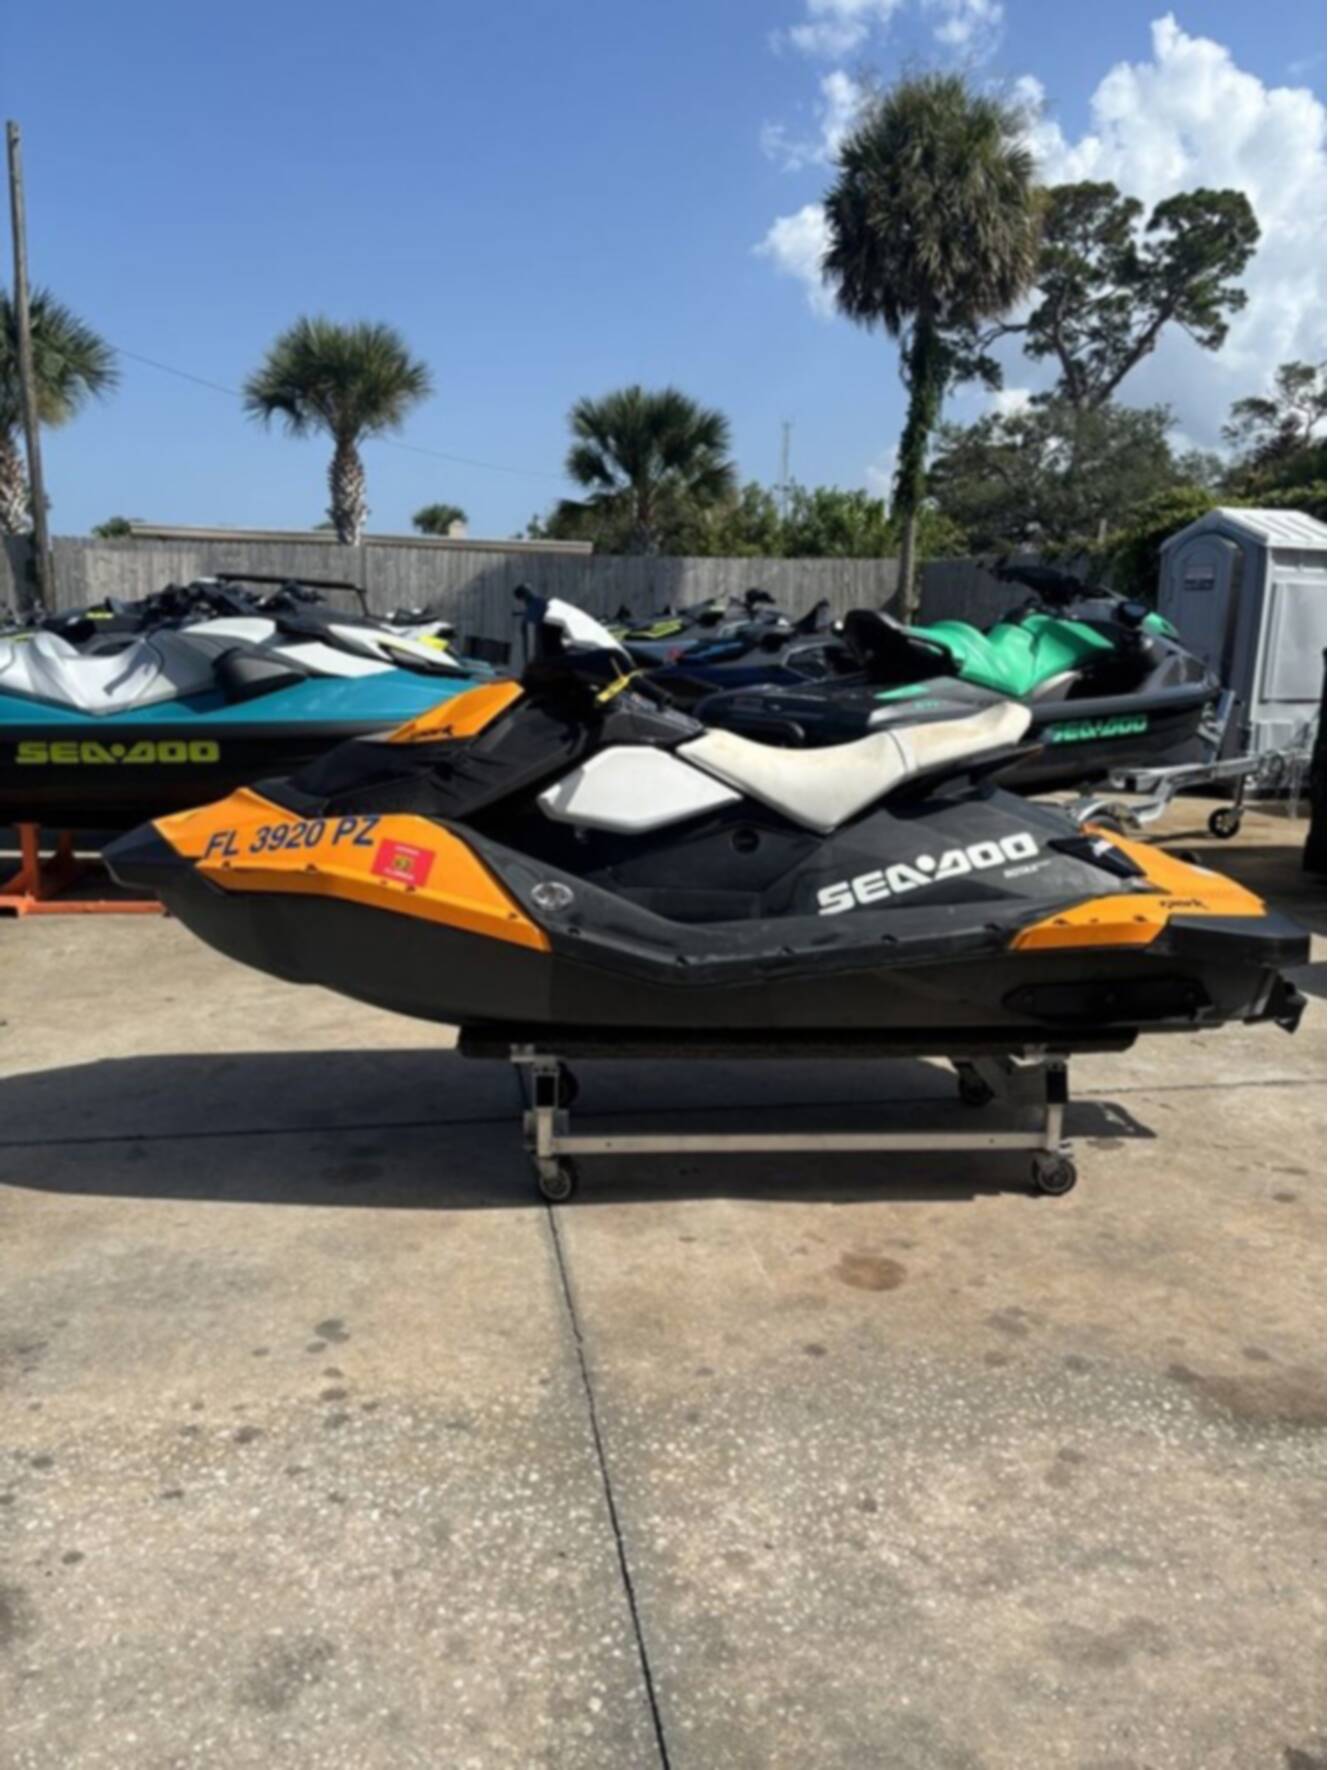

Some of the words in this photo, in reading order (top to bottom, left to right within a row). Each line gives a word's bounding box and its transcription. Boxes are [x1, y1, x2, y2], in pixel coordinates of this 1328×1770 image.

[204, 829, 238, 859] FL
[250, 819, 326, 852] 3920
[331, 815, 379, 845] PZ
